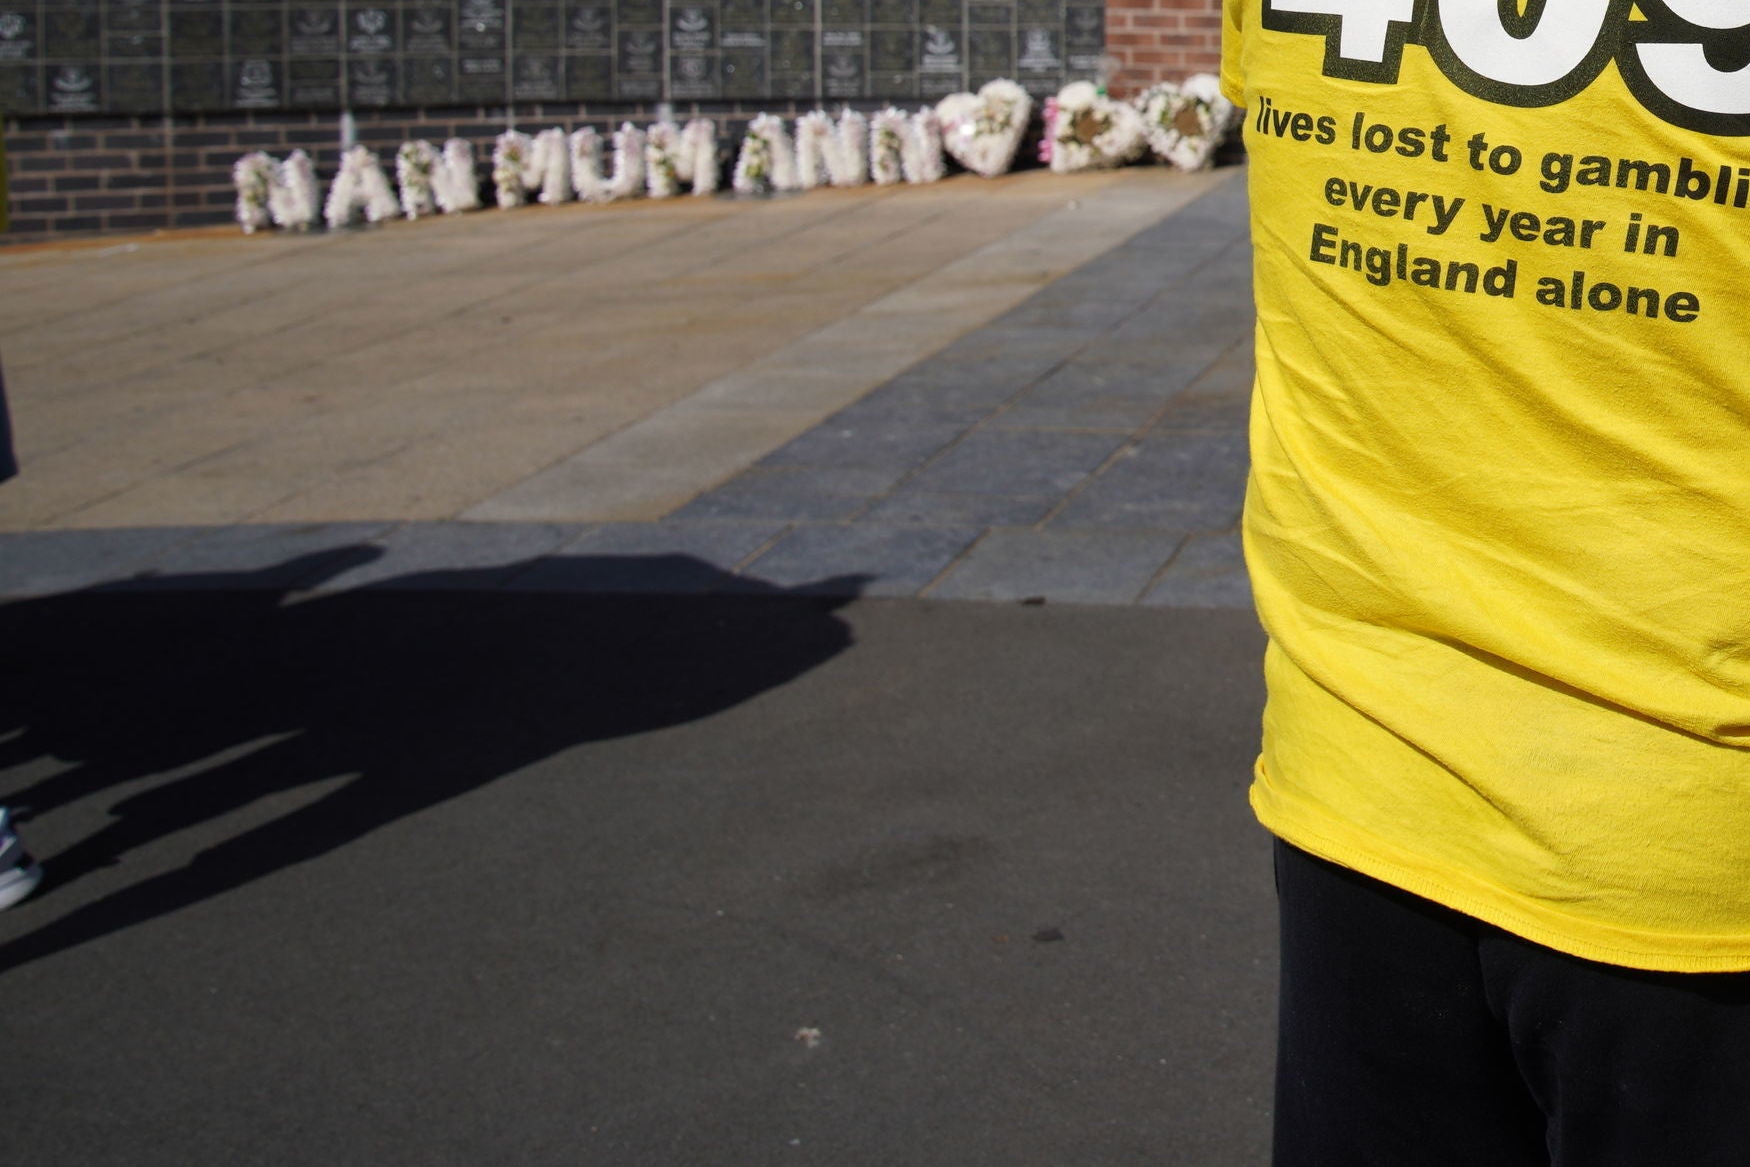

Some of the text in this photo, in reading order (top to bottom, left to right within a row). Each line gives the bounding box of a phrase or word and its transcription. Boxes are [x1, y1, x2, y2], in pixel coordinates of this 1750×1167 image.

[1256, 95, 1337, 145] lives
[1351, 111, 1451, 163] lost
[1468, 131, 1523, 177] to
[1324, 177, 1680, 258] every year in
[1309, 222, 1701, 324] England alone
